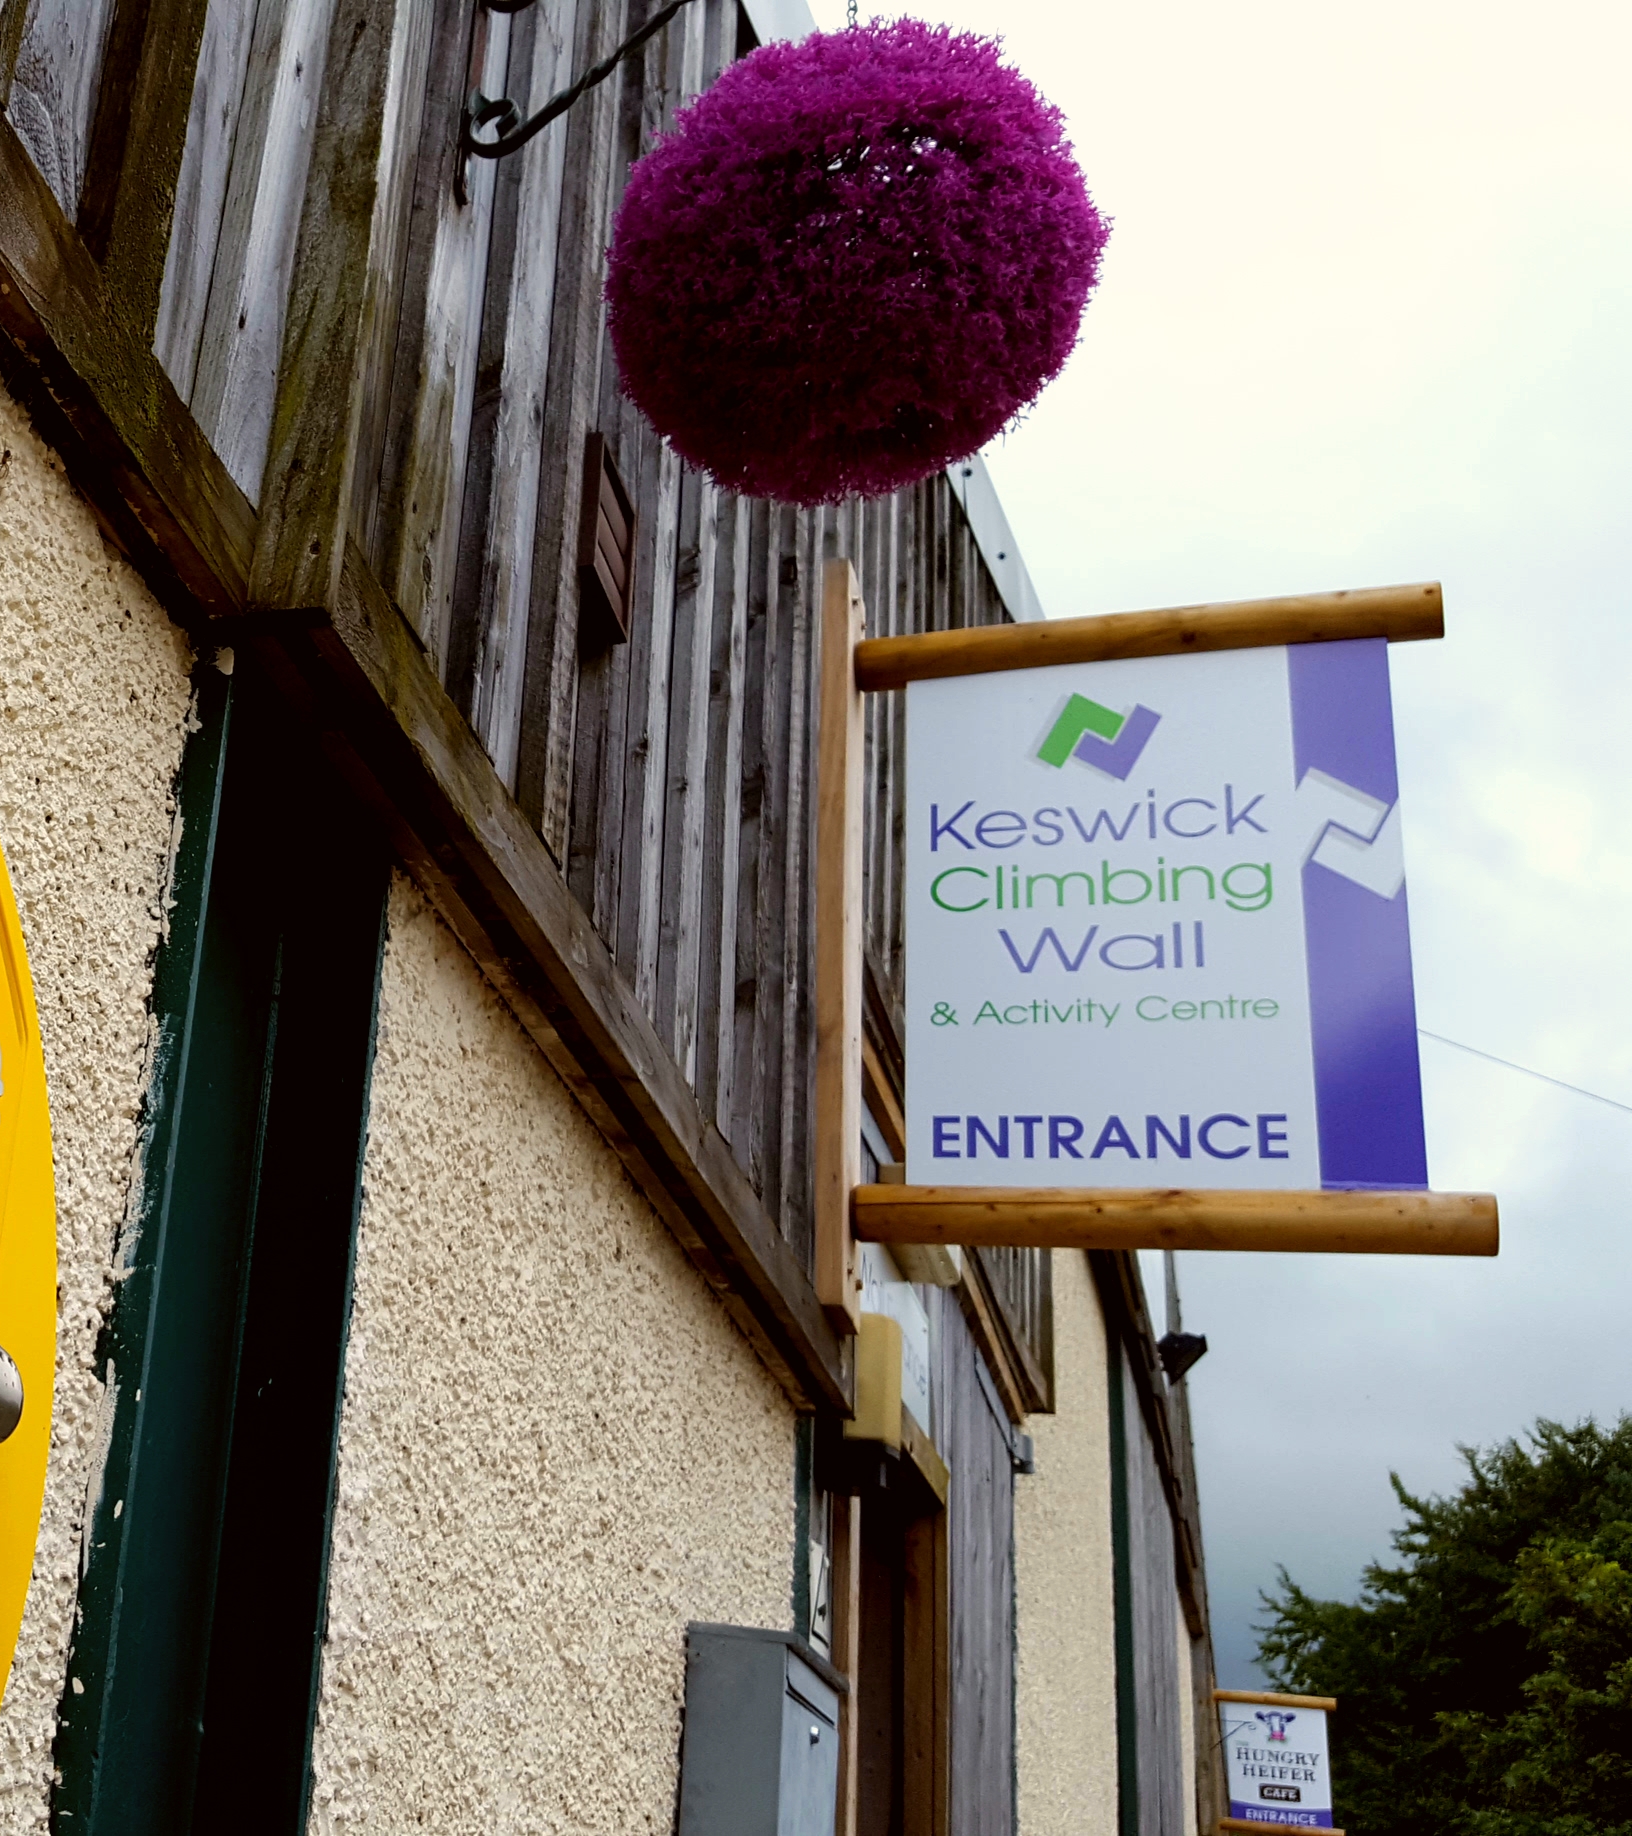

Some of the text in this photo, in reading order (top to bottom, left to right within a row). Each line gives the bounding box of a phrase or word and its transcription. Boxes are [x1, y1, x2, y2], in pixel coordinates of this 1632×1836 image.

[929, 783, 1269, 852] Keswick
[929, 856, 1273, 912] Climbing
[997, 921, 1206, 974] Wall
[930, 994, 1280, 1029] & Activity Centre
[931, 1113, 1290, 1160] ENTRANCE
[1236, 1746, 1320, 1766] HUNGRY
[1242, 1763, 1316, 1782] HEIFER
[1263, 1786, 1298, 1799] CAFE
[1245, 1808, 1318, 1826] ENTRANCE
